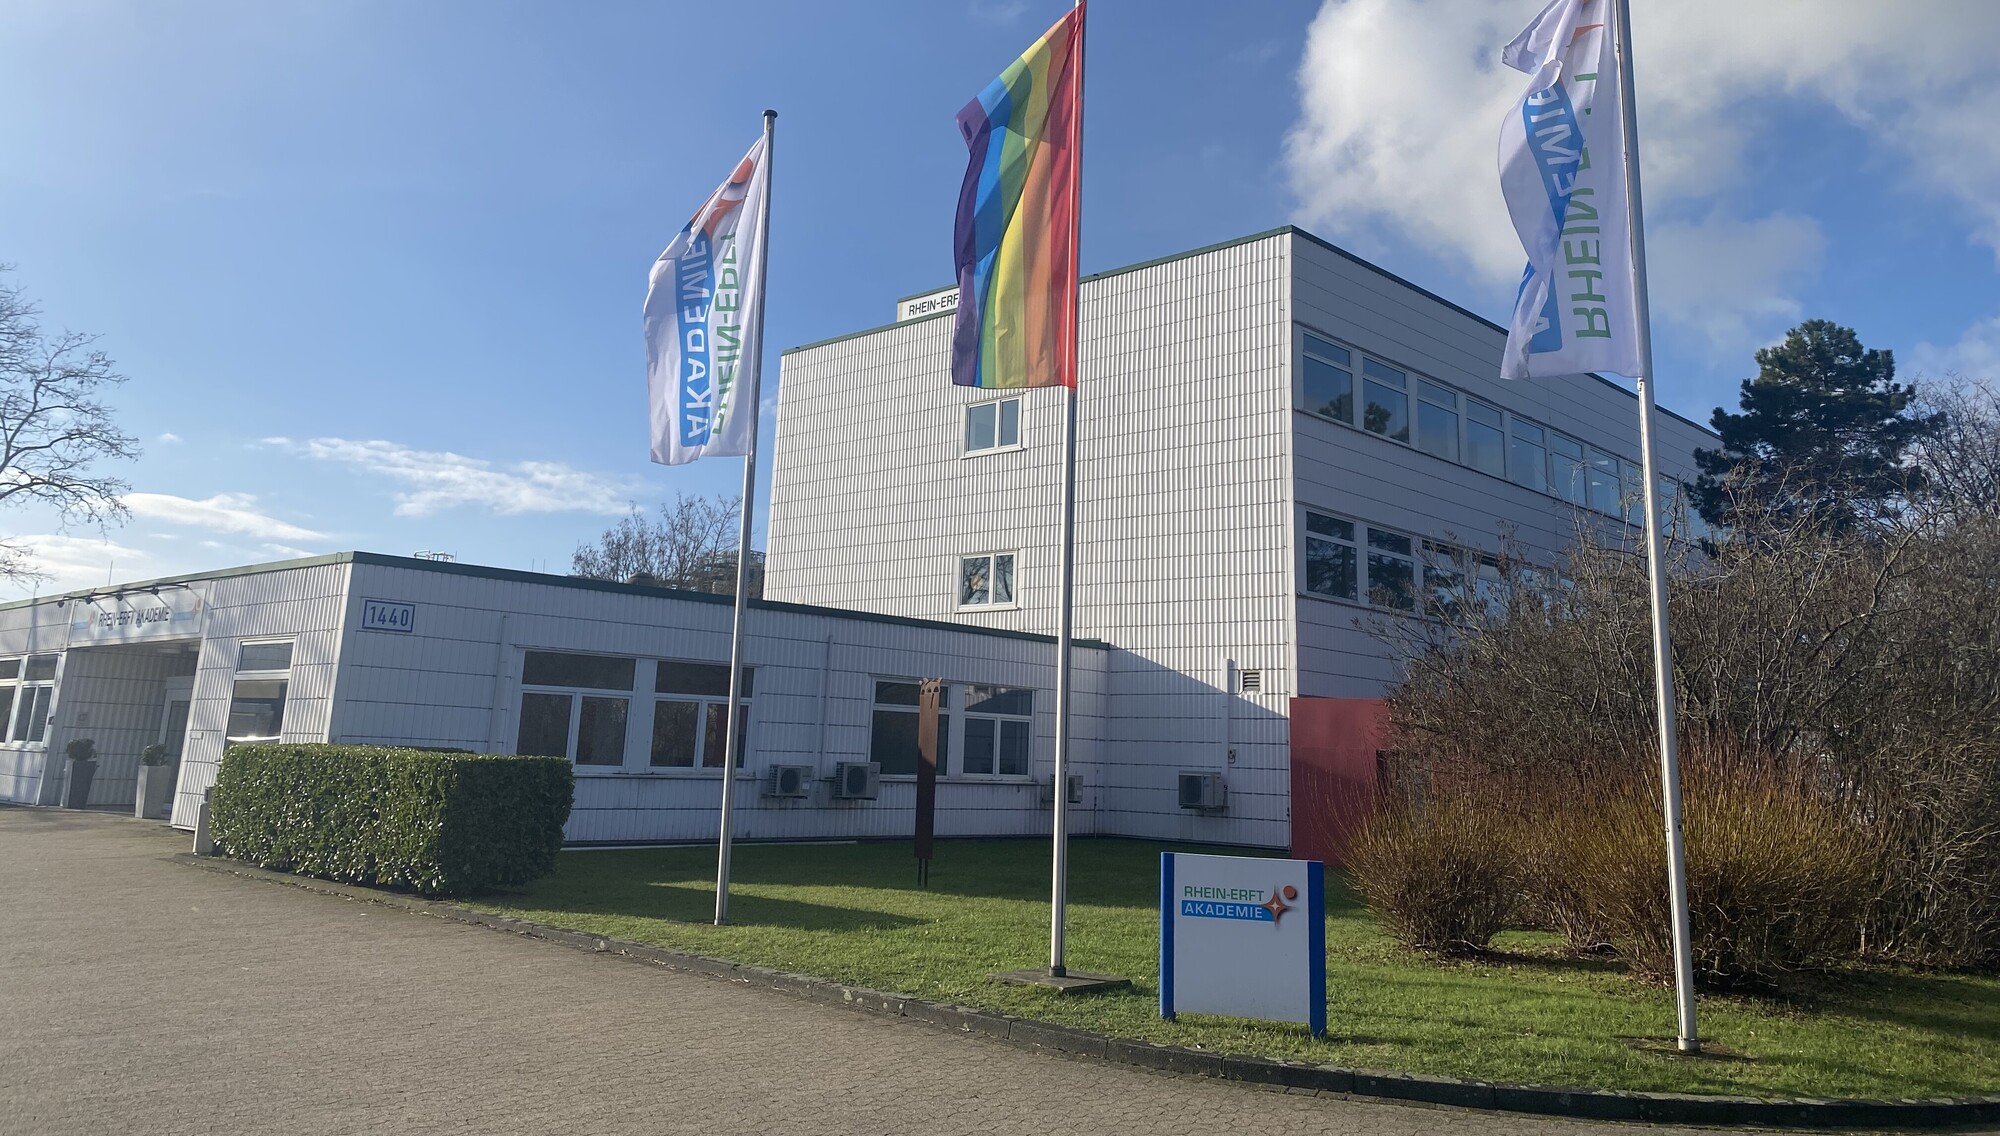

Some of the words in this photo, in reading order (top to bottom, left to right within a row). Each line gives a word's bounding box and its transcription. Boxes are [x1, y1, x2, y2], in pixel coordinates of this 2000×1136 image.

[98, 611, 135, 627] RHEIN-ERFT
[135, 607, 169, 625] AKADEMIE
[370, 606, 409, 627] 1440
[1184, 885, 1265, 902] RHEIN-ERFT
[1184, 902, 1264, 919] AKADEMIE
